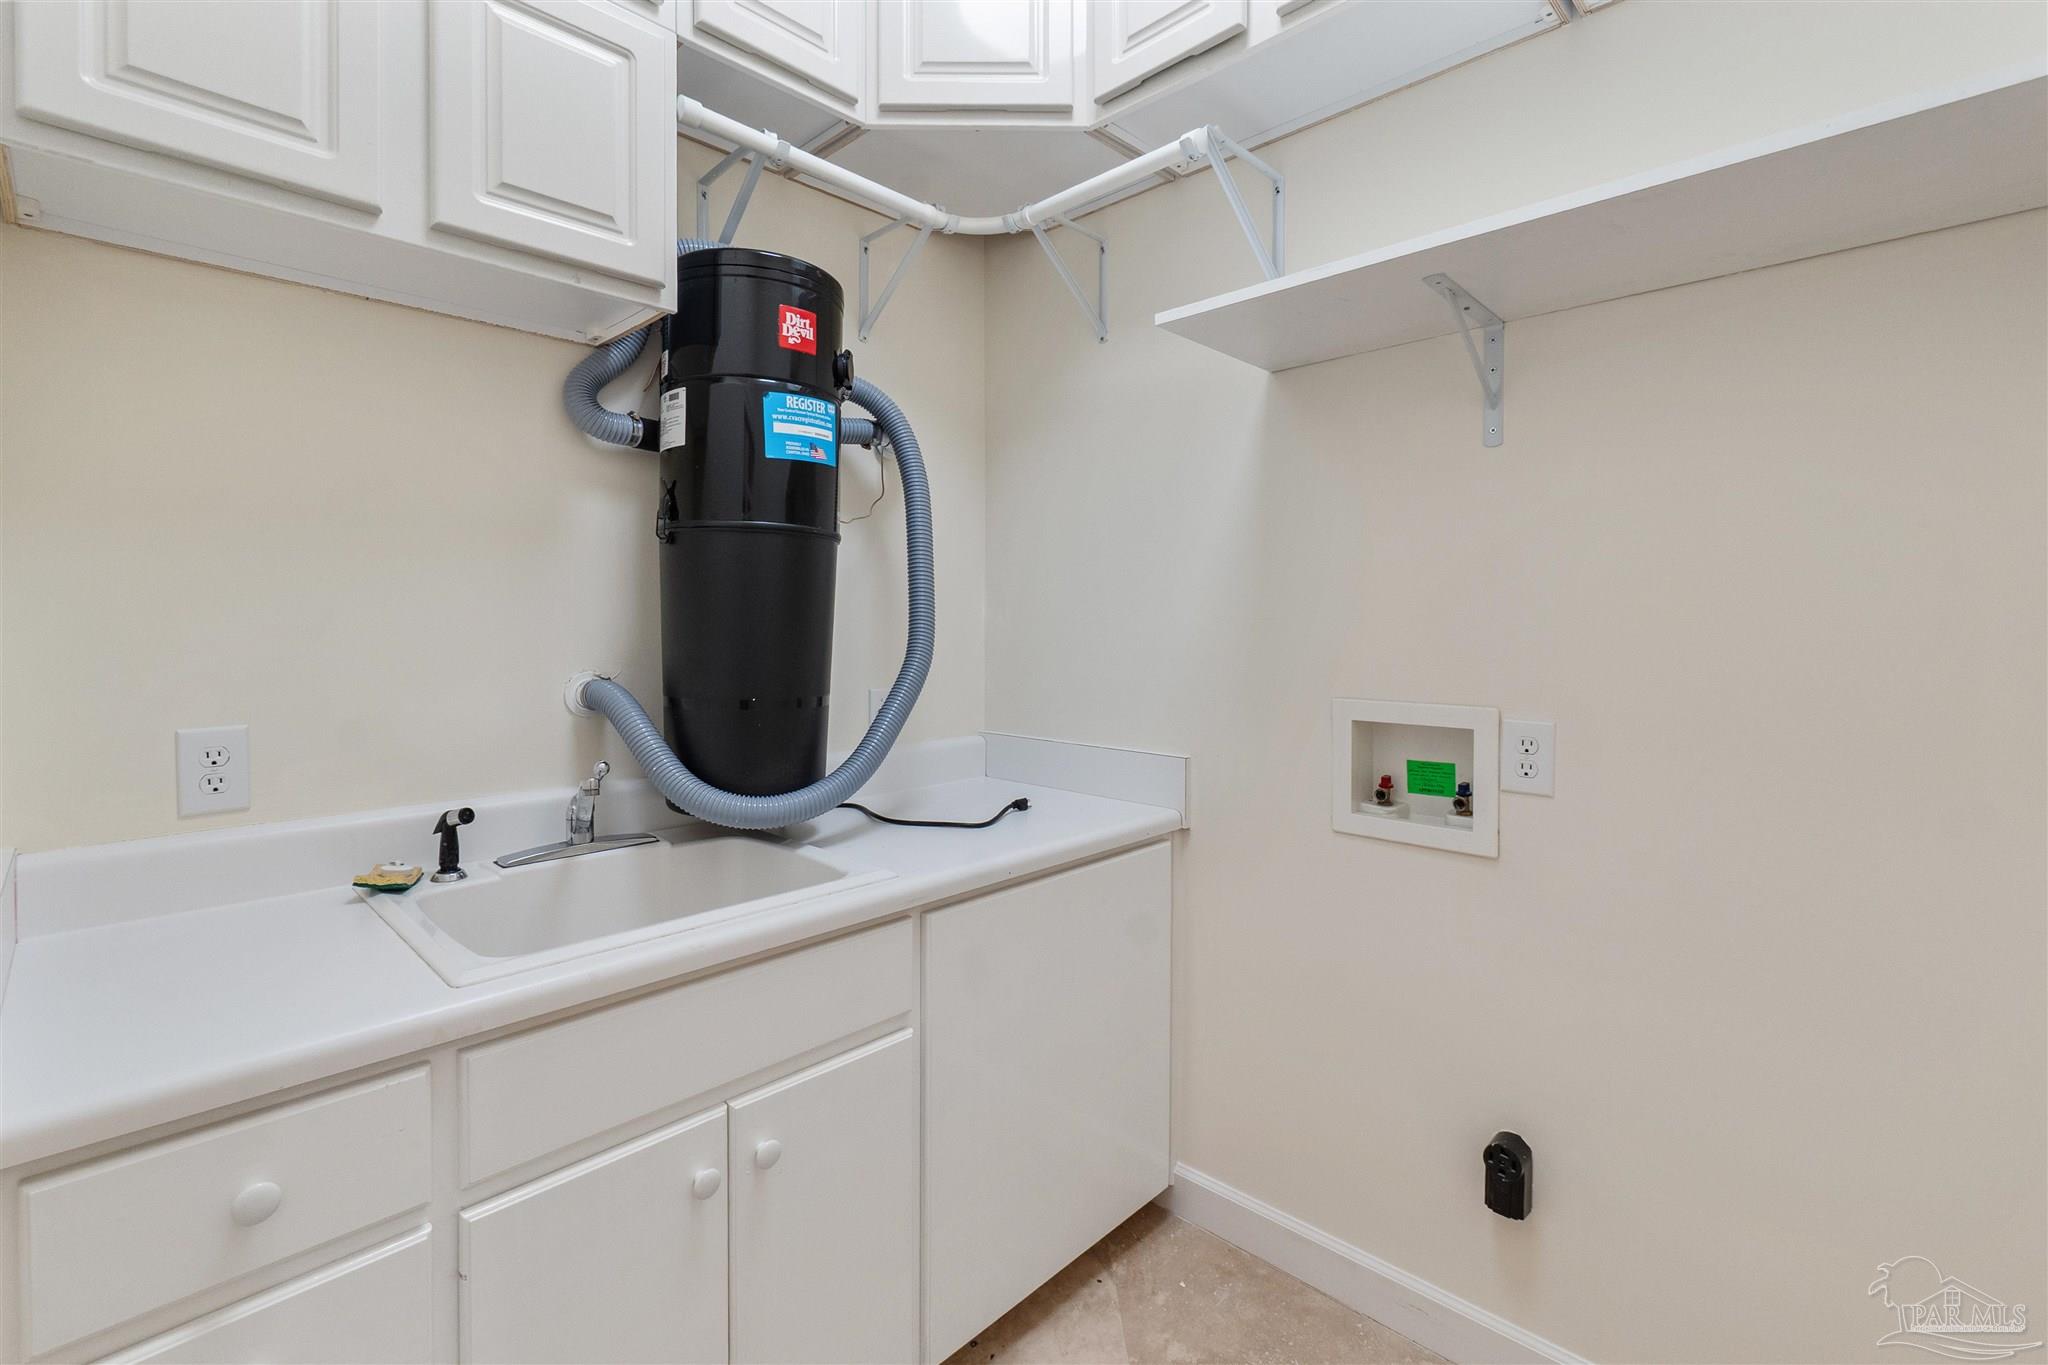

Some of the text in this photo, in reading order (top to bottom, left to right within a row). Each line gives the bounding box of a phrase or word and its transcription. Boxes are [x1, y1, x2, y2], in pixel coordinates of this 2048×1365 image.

[785, 311, 810, 329] Dirt
[782, 323, 814, 340] Devil
[786, 396, 826, 414] REGISTER
